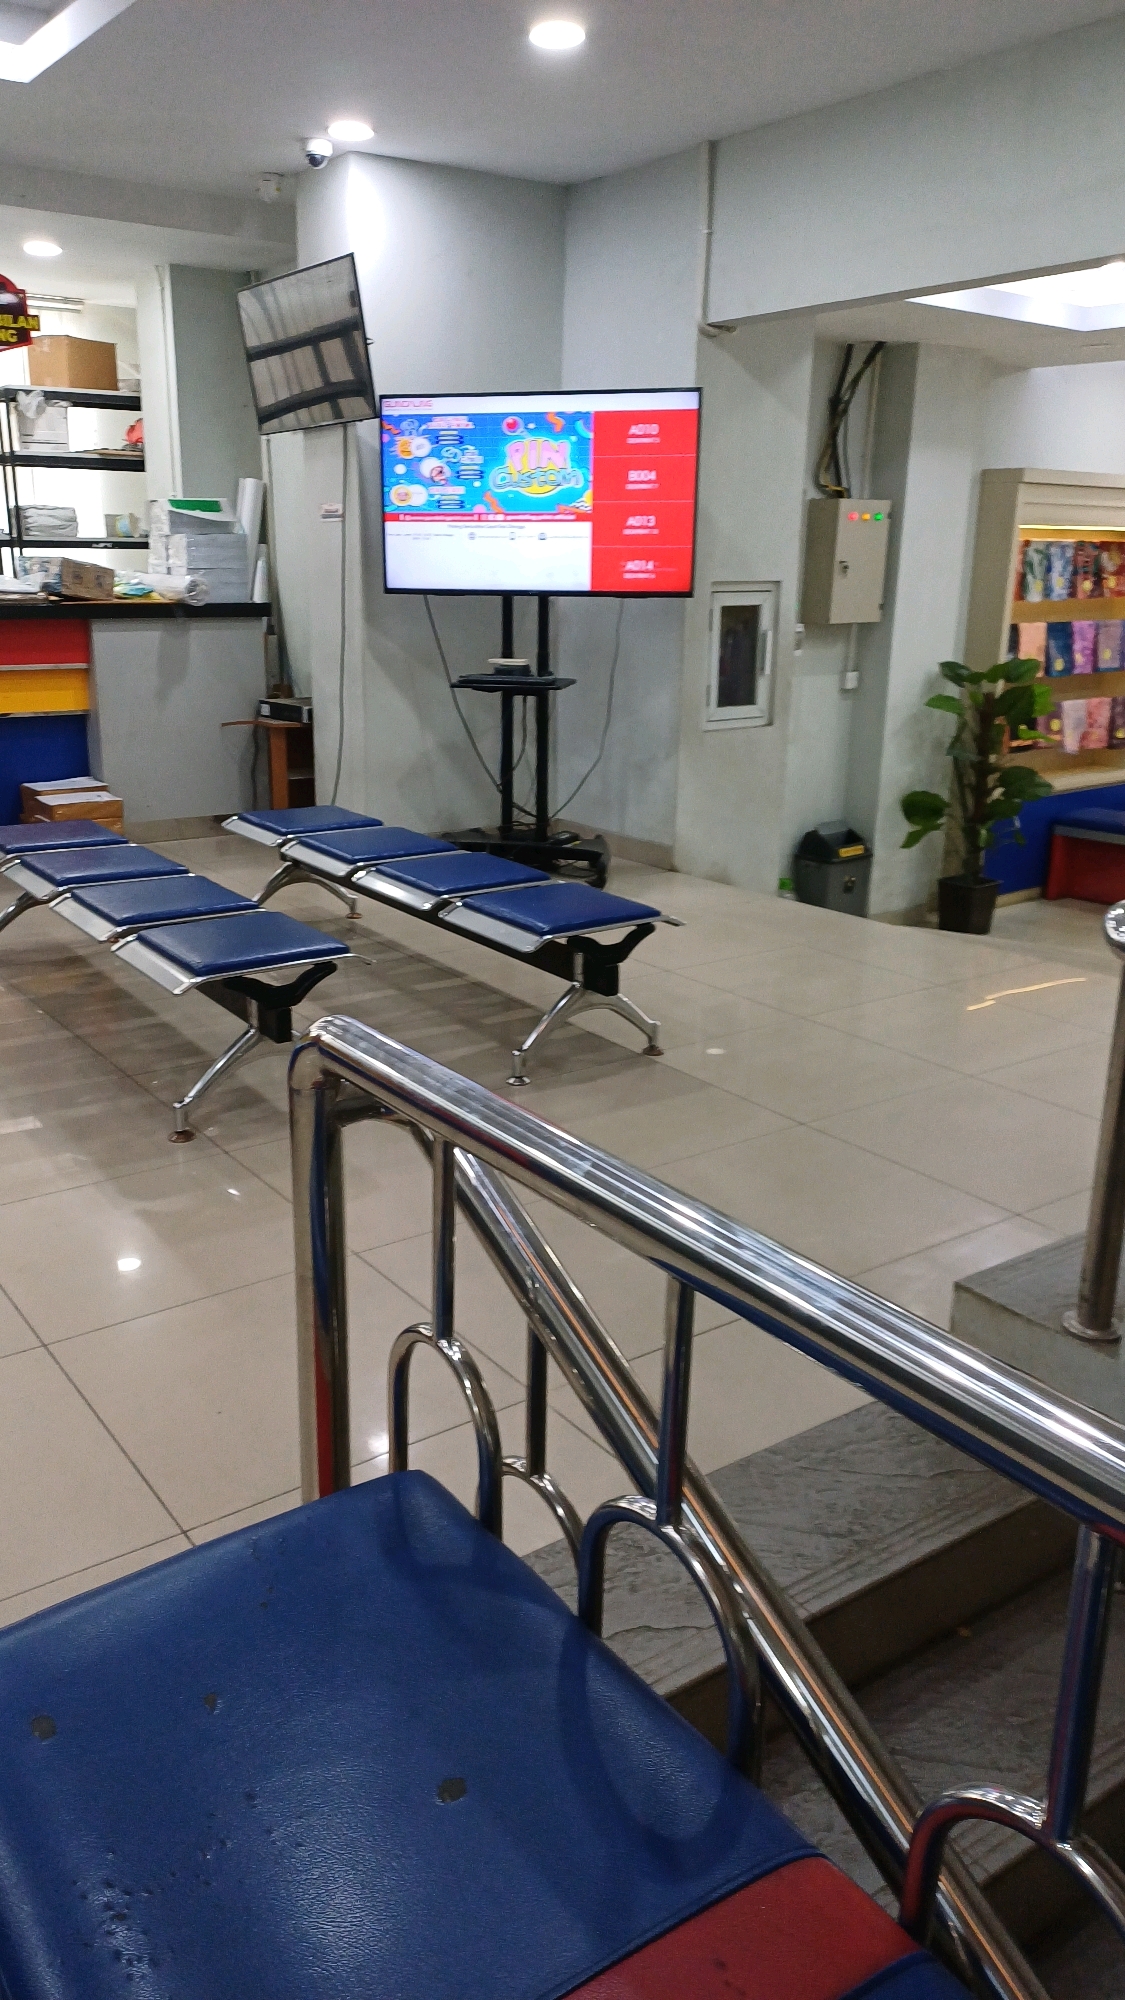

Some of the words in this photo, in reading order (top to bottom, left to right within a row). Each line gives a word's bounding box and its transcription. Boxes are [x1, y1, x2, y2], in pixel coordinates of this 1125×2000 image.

[628, 423, 660, 435] A010
[507, 439, 567, 472] PIN
[628, 470, 657, 482] B004
[625, 515, 657, 527] A013
[624, 560, 655, 571] A014
